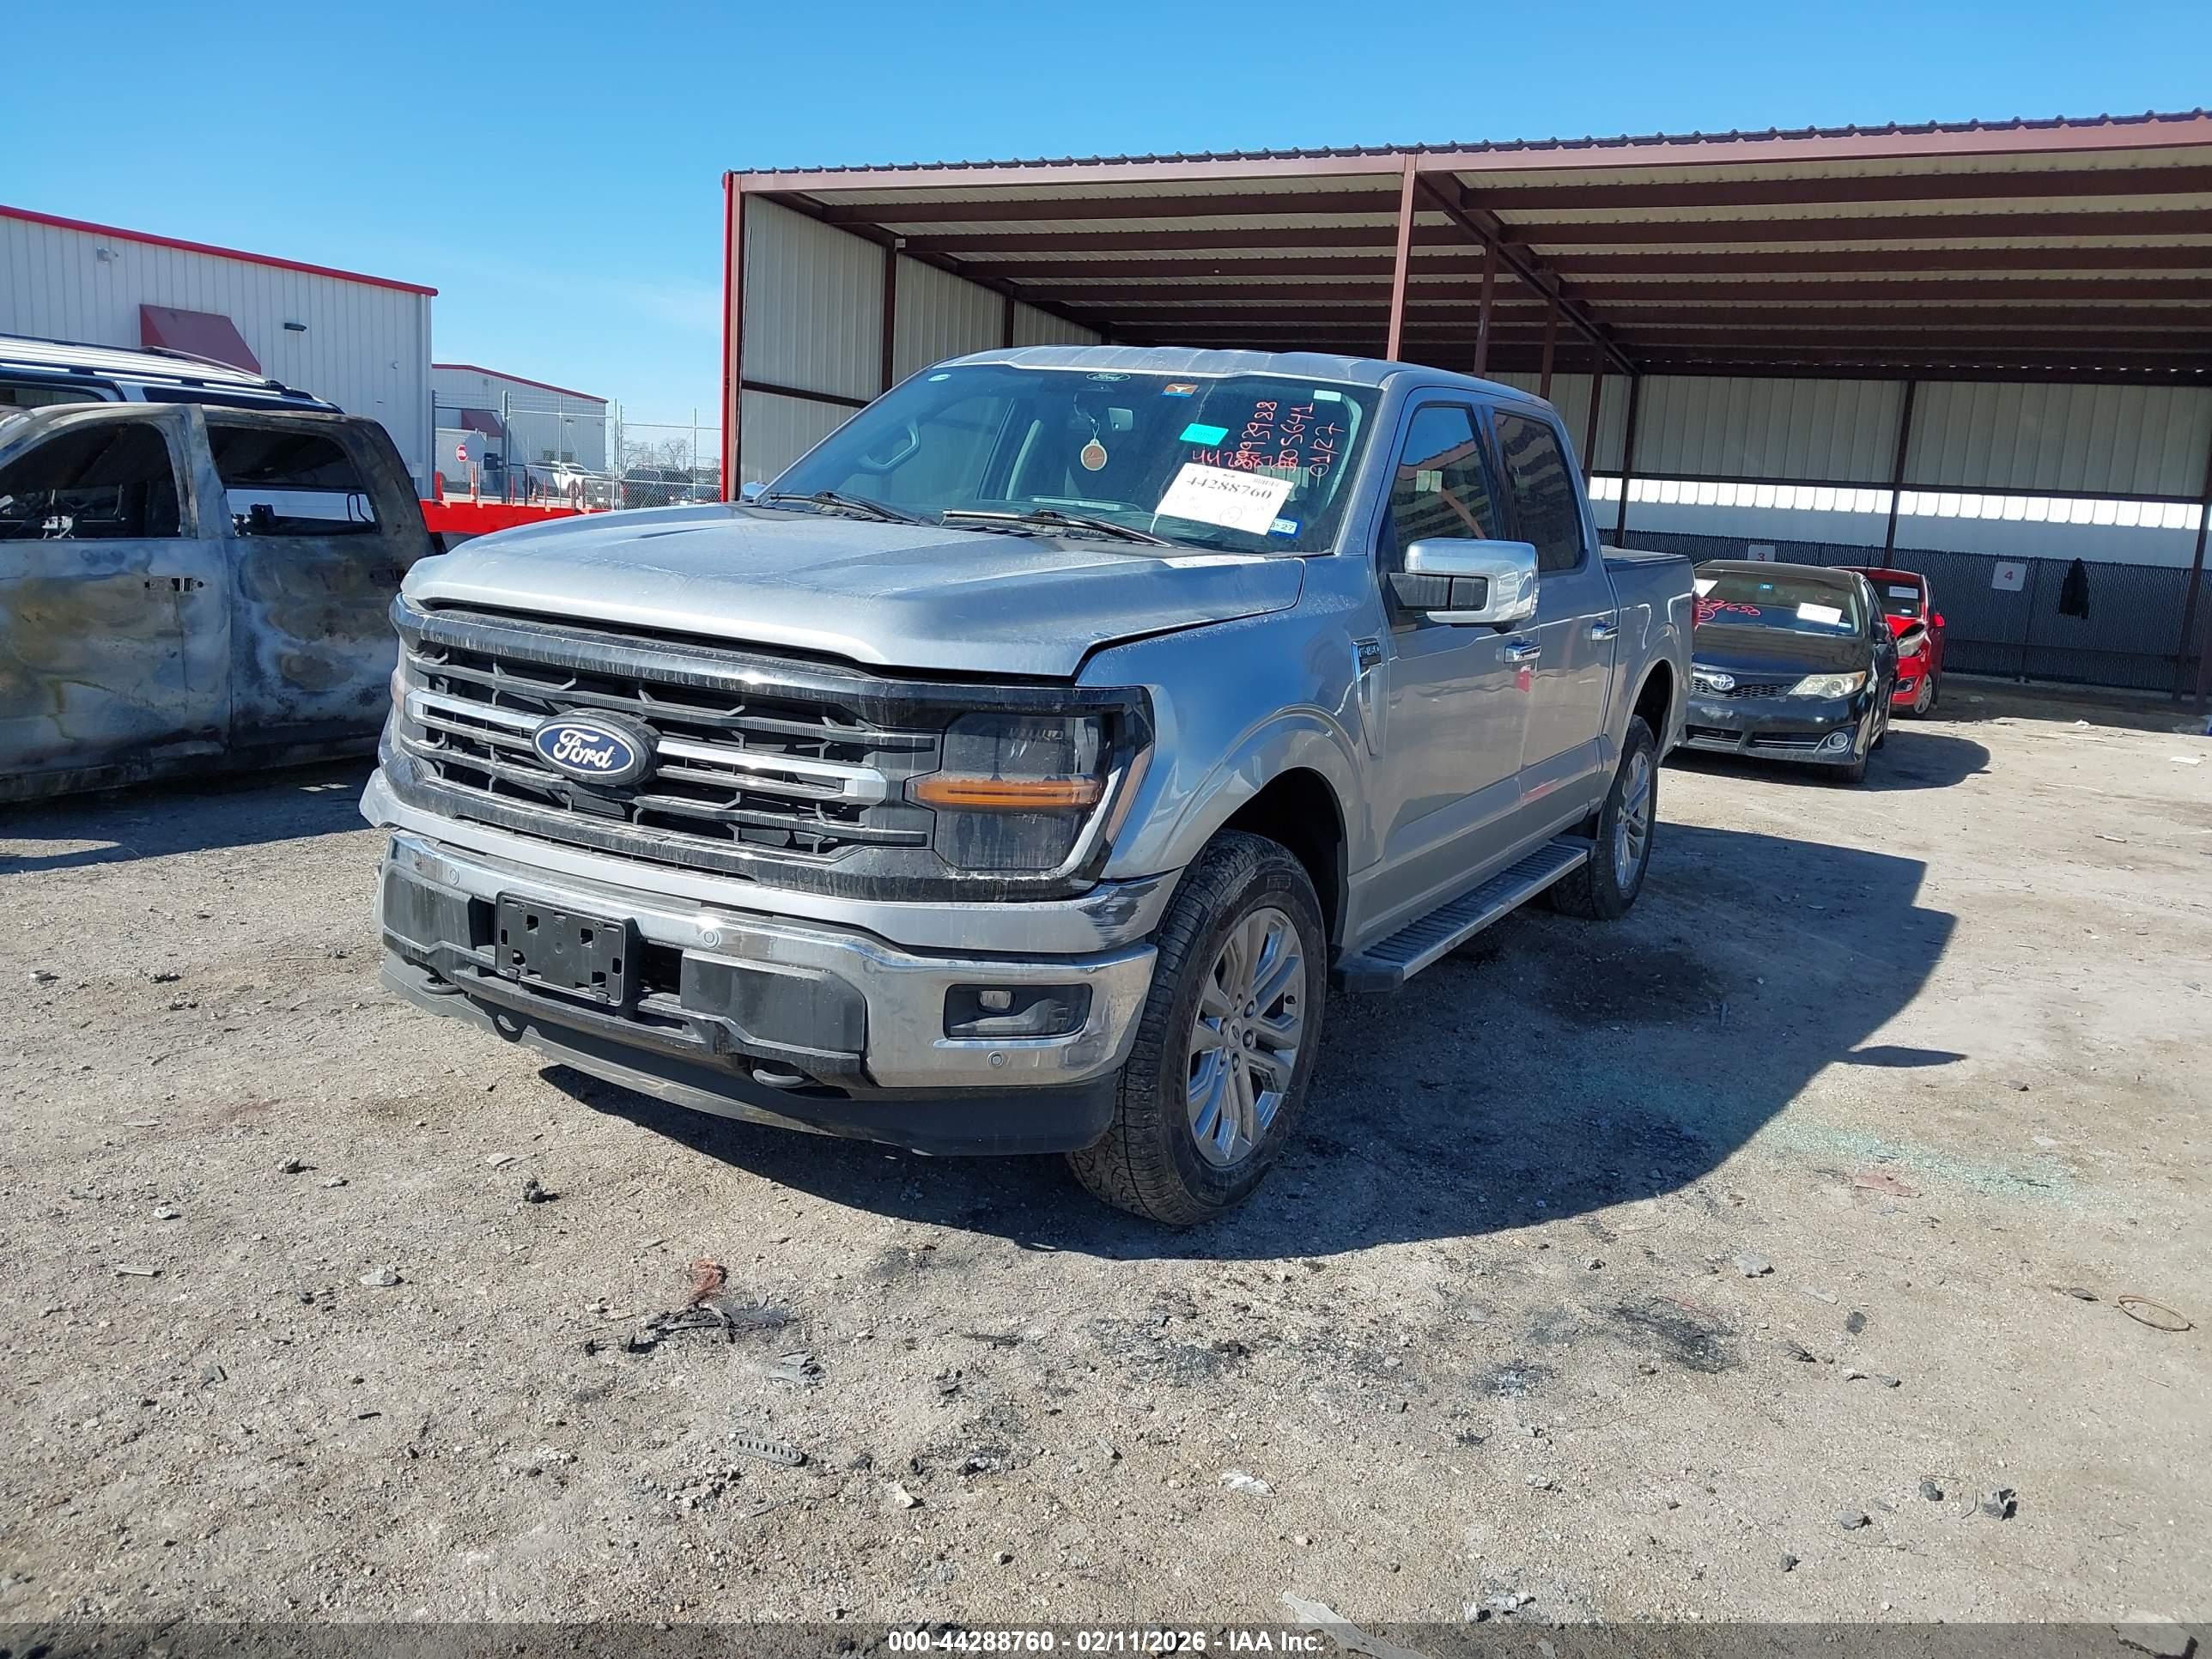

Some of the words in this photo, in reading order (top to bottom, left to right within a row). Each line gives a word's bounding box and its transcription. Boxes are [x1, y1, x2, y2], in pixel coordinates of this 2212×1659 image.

[1186, 477, 1273, 499] 44288760
[1758, 552, 1765, 562] 3
[2004, 570, 2014, 580] 4
[553, 728, 615, 769] Ford
